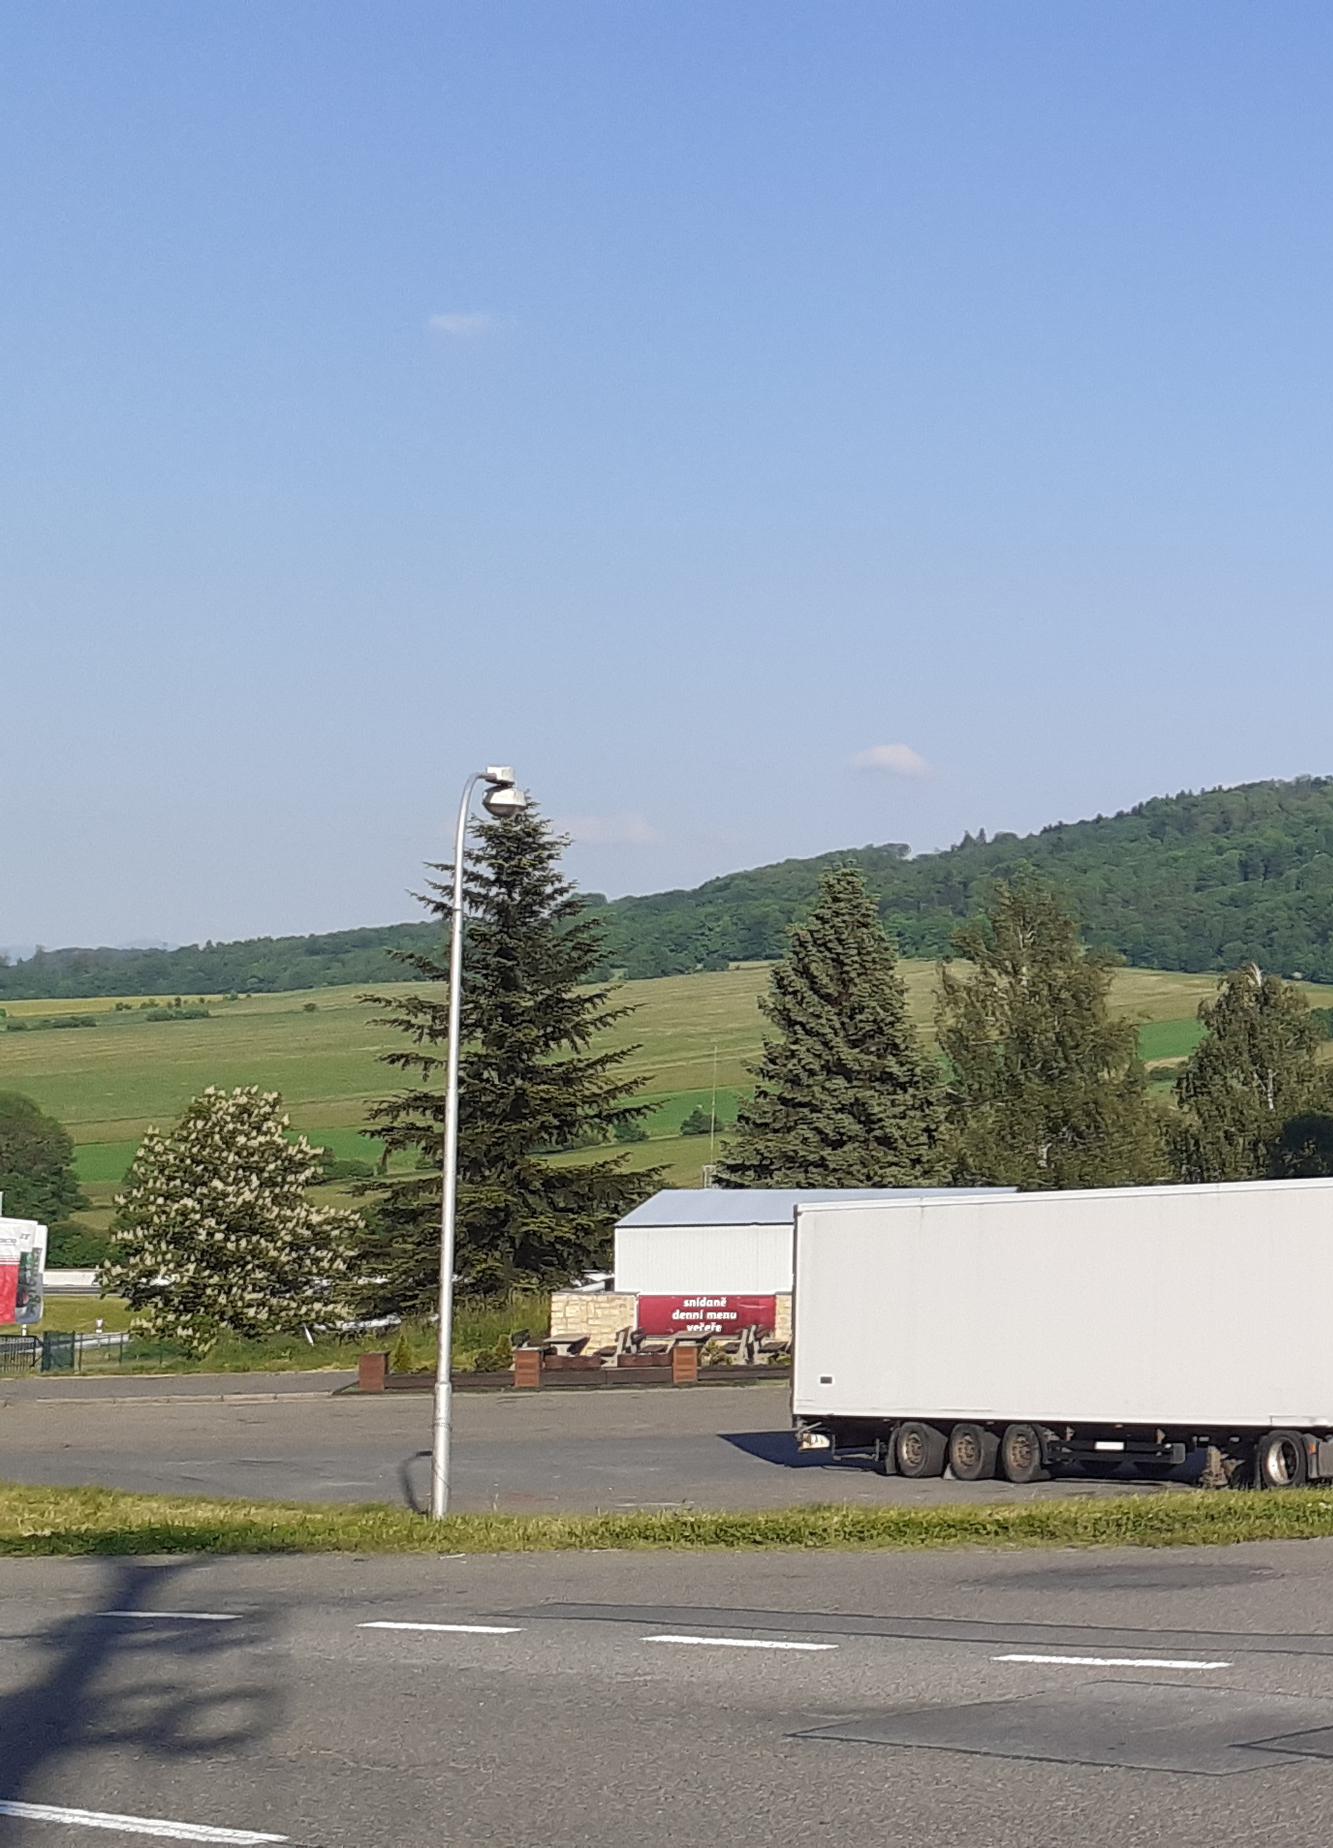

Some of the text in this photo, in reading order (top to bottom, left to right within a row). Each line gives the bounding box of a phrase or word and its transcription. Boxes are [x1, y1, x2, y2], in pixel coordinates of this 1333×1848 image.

[683, 1296, 727, 1307] snídaně
[672, 1309, 738, 1320] denní menu
